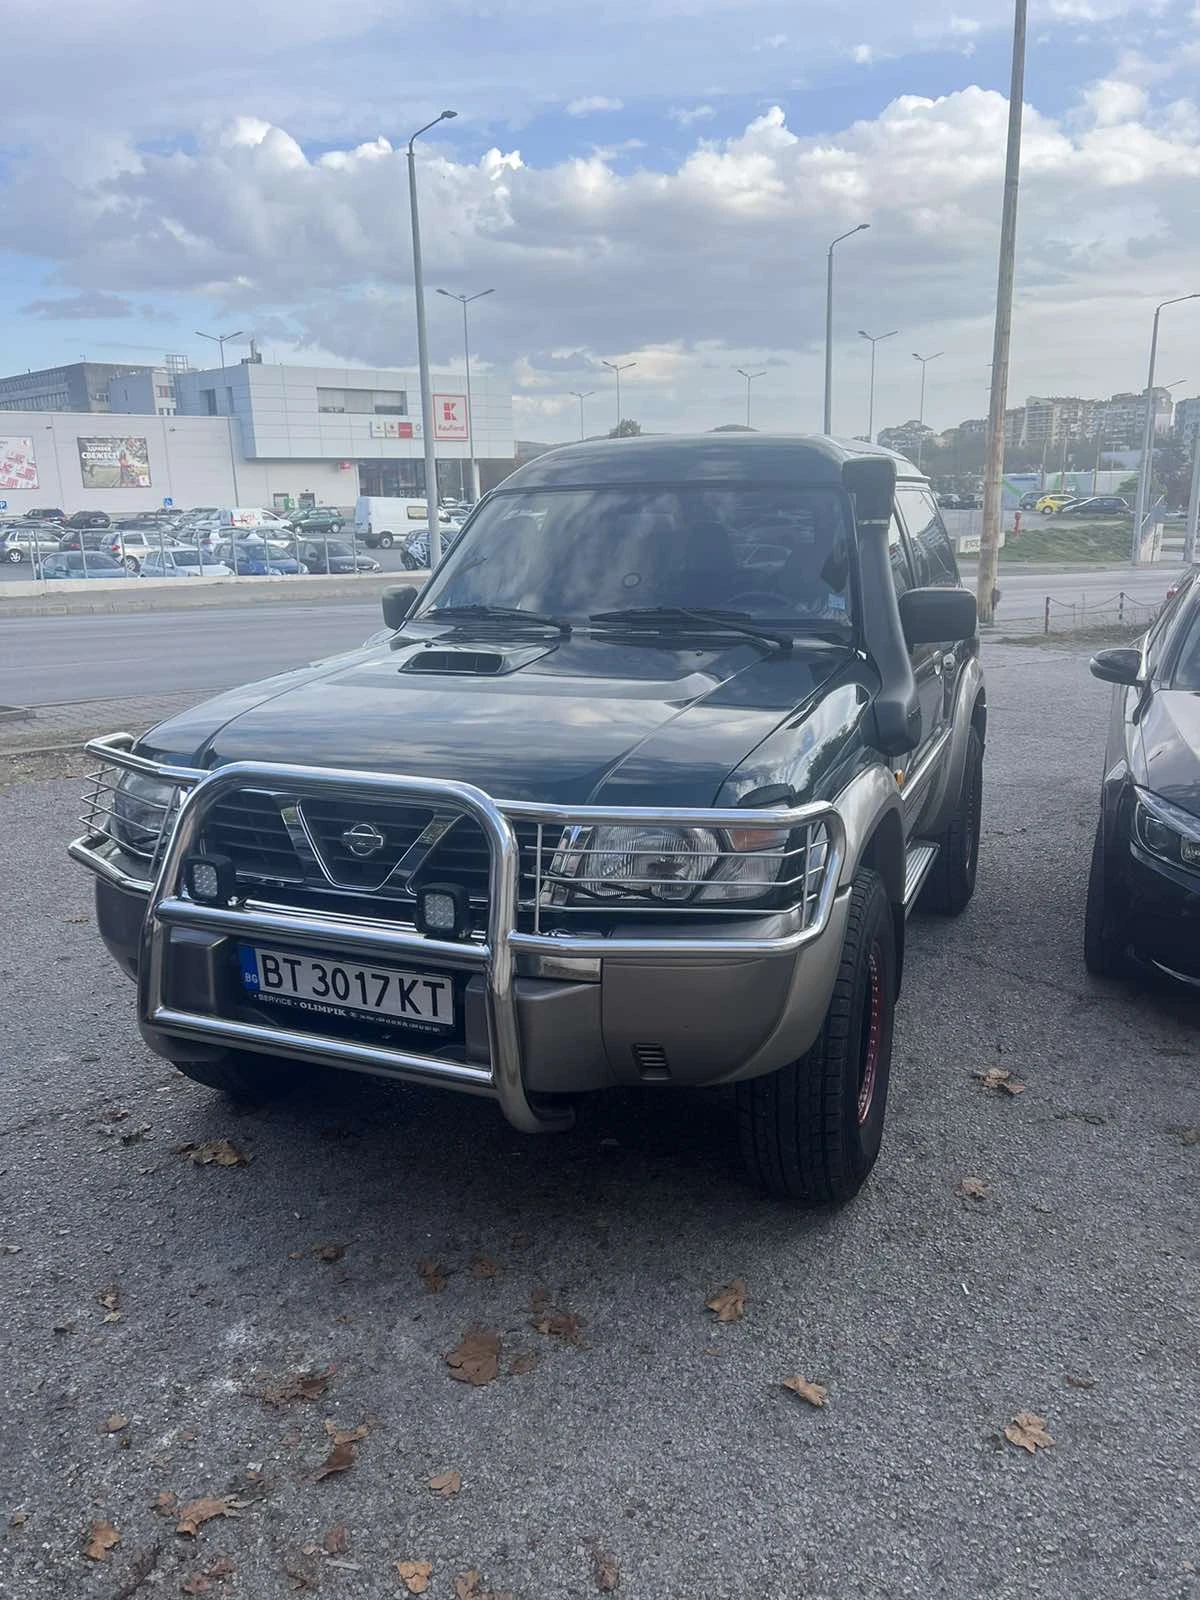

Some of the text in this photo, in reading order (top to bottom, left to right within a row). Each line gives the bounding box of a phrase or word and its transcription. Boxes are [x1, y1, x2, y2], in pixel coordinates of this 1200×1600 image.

[244, 955, 445, 1016] BG BT 3017 KT
[300, 1001, 346, 1017] OLIMPIK
